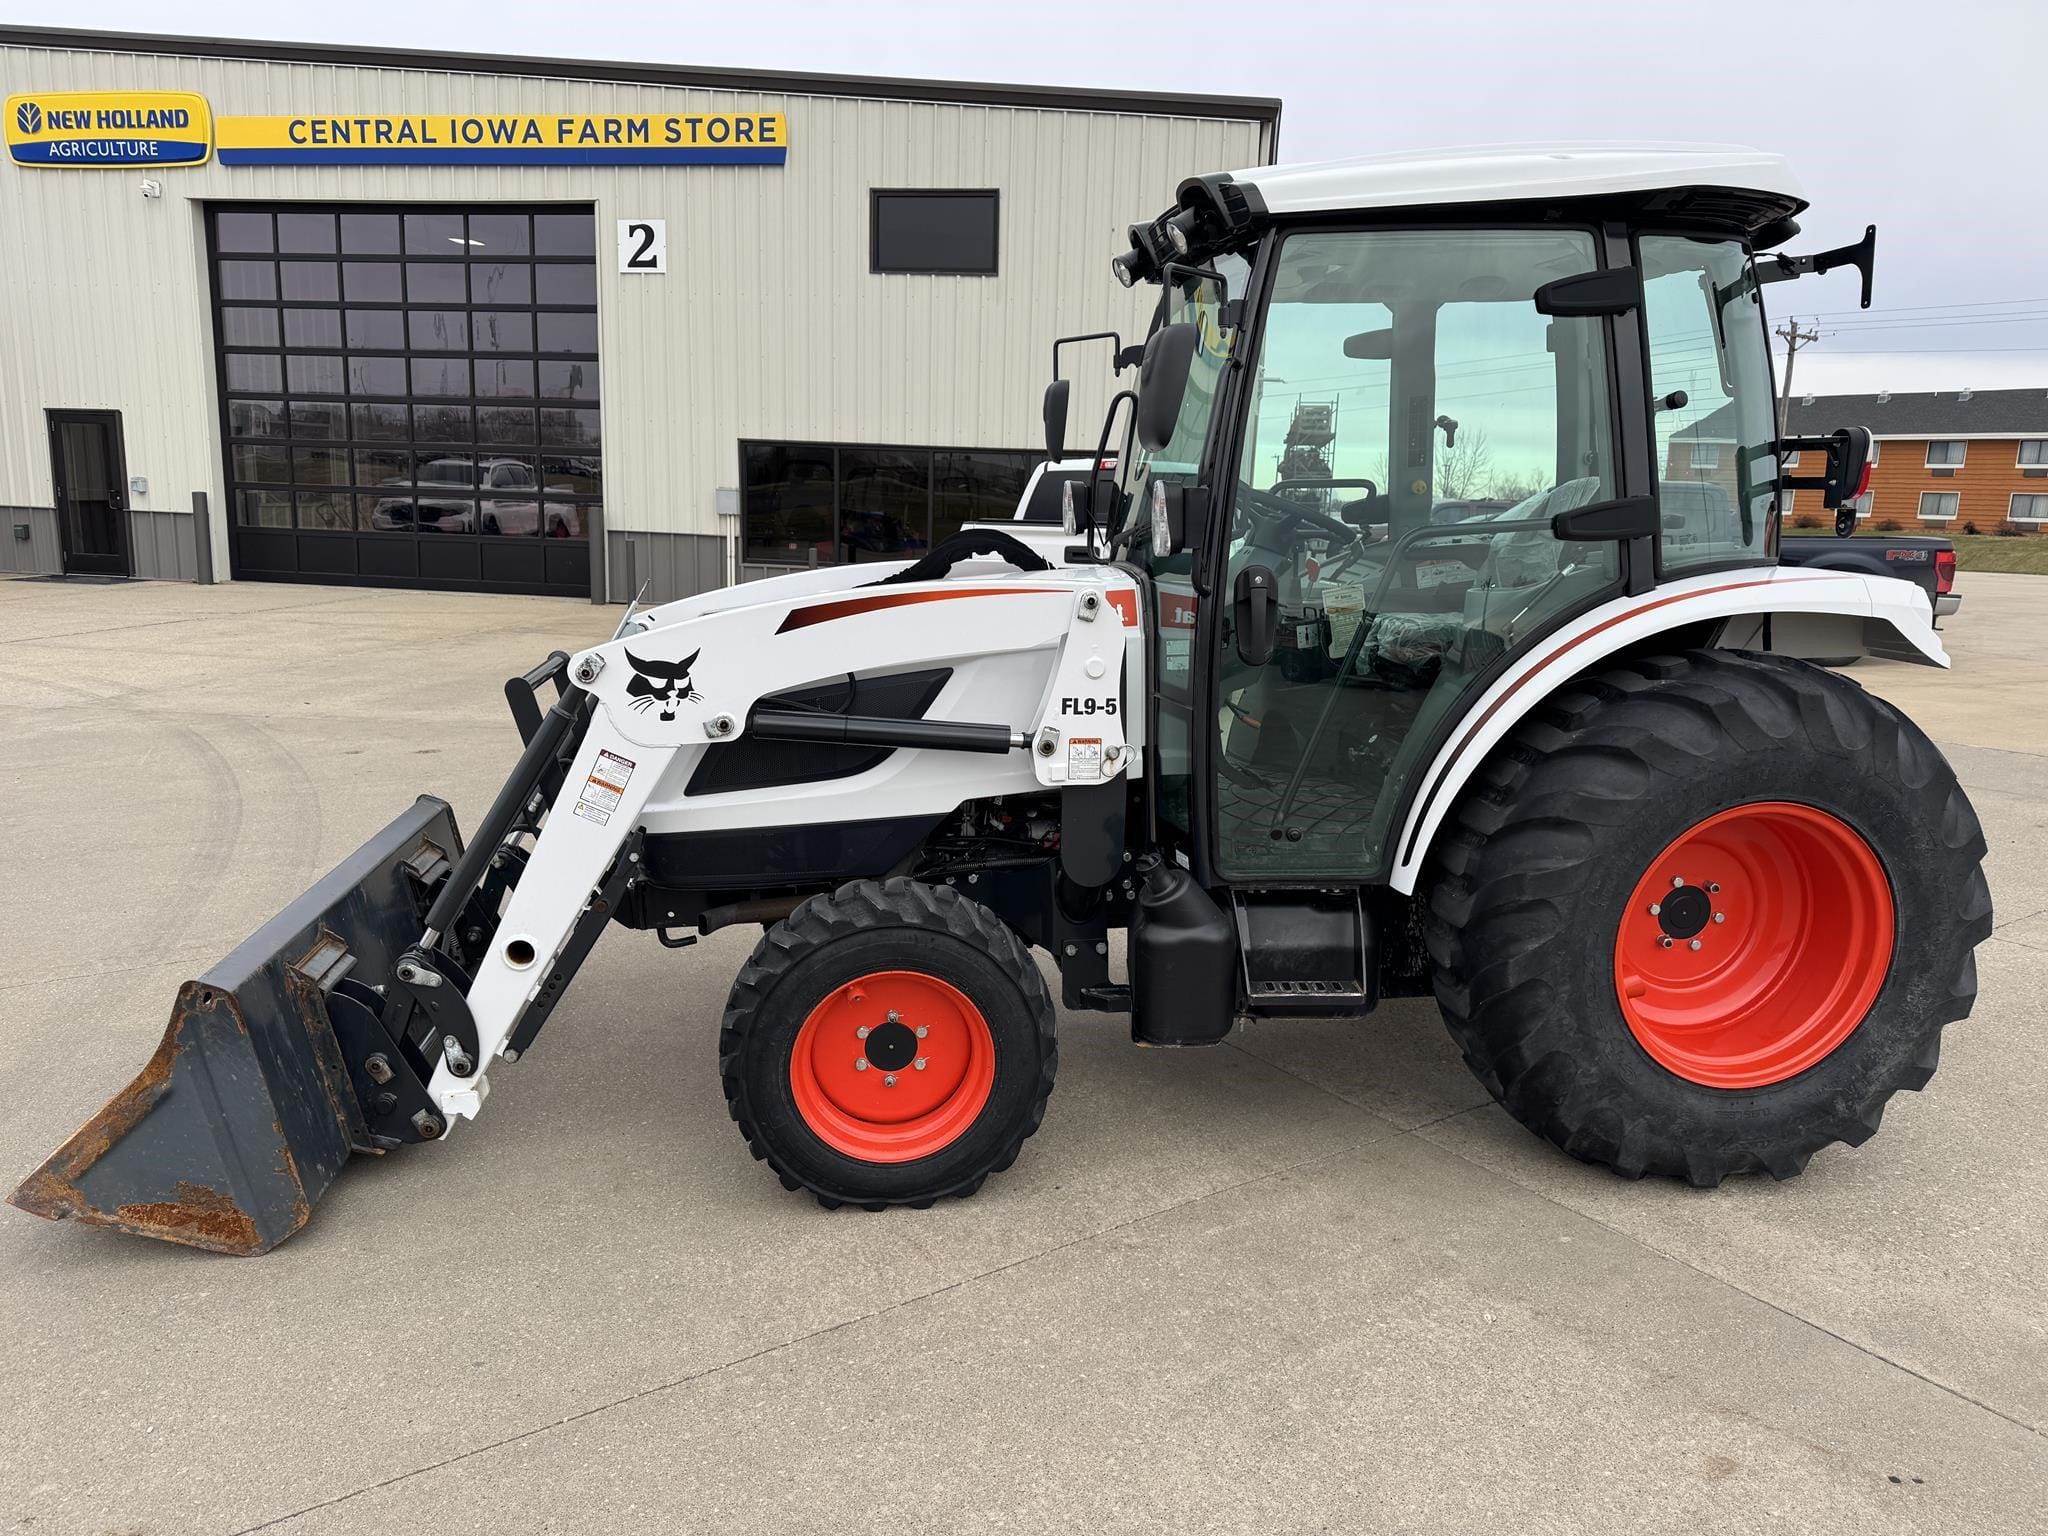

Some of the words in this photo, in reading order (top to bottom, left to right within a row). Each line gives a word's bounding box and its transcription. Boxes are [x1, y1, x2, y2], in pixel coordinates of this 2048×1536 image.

[47, 110, 91, 130] NEW
[97, 109, 189, 129] HOLLAND
[288, 119, 437, 144] CENTRAL
[451, 119, 543, 144] IOWA
[557, 118, 649, 144] FARM
[664, 117, 777, 143] STORE
[49, 141, 158, 156] AGRICULTURE
[627, 223, 658, 268] 2
[1061, 698, 1117, 715] FL9-5
[609, 752, 633, 768] DANGER
[598, 779, 622, 794] WARNING
